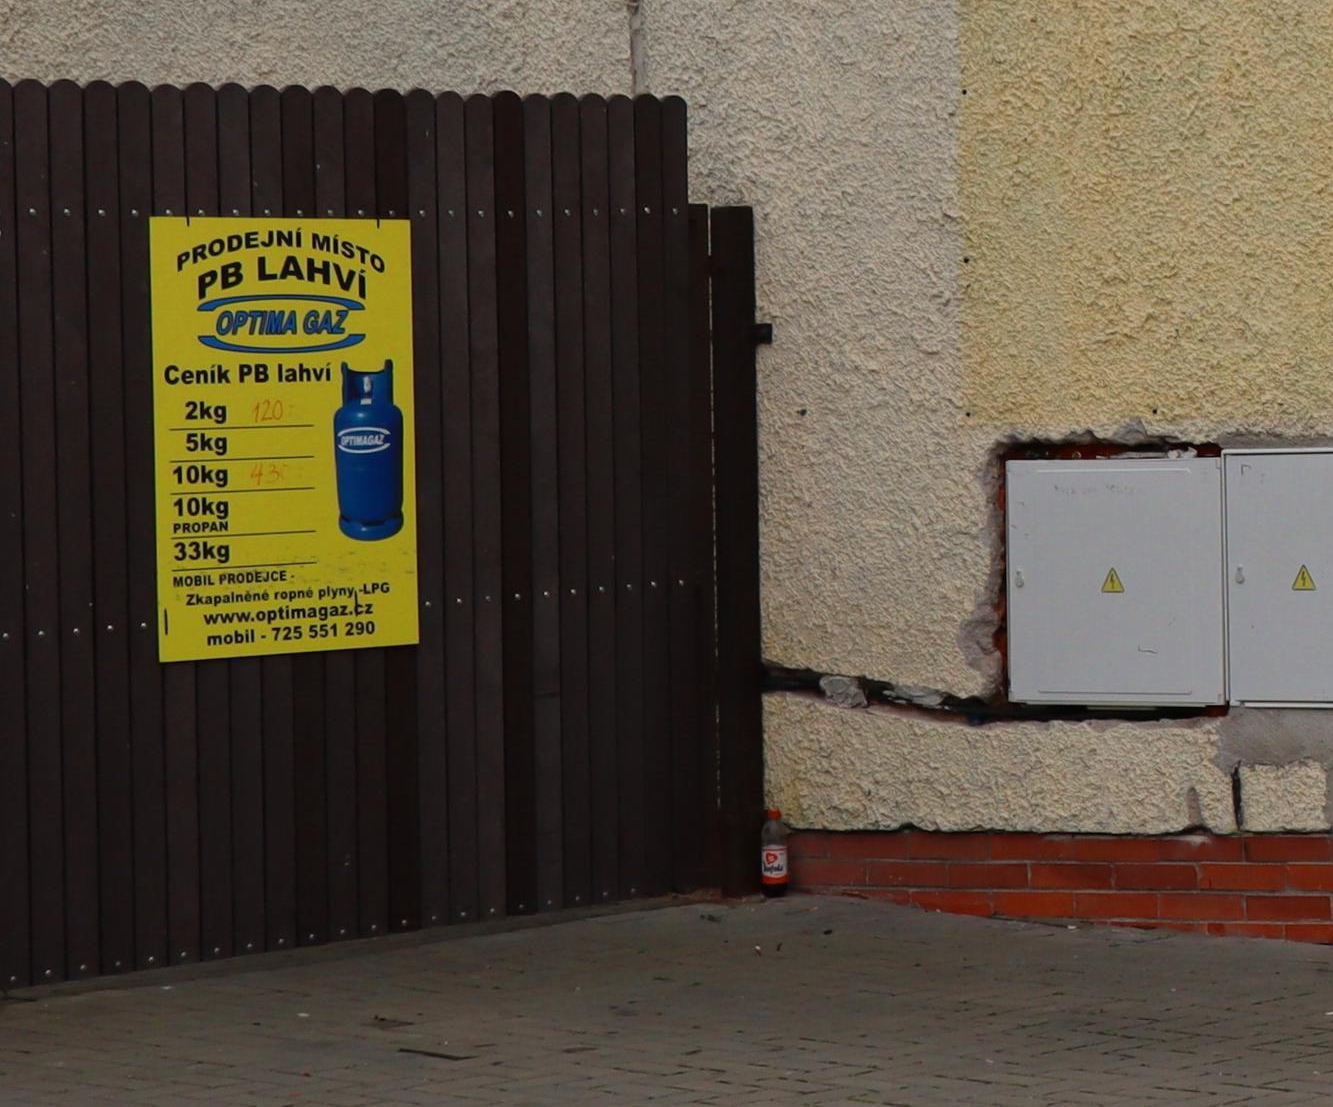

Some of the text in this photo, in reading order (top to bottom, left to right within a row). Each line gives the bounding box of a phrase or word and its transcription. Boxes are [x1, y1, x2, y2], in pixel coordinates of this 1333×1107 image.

[177, 228, 385, 274] PRODEJNÍ MÍSTO
[198, 255, 366, 301] PB LAHVÍ
[215, 309, 350, 336] OPTIMA GAZ
[164, 362, 332, 386] Ceník PB lahví
[185, 400, 227, 425] 2kg
[186, 433, 228, 456] 5kg
[172, 465, 229, 488] 10kg
[173, 497, 230, 520] 10kg
[172, 521, 229, 534] PROPAN
[174, 541, 231, 565] 33kg
[172, 575, 216, 588] MOBIL
[219, 570, 287, 585] PRODEJCE
[186, 590, 270, 607] Zkapalněné
[274, 588, 314, 602] ropné
[318, 586, 355, 601] plyny
[204, 602, 374, 626] www.optimagaz.cz
[206, 630, 256, 647] mobil
[271, 626, 303, 642] 725
[308, 623, 339, 639] 551
[345, 621, 376, 637] 290
